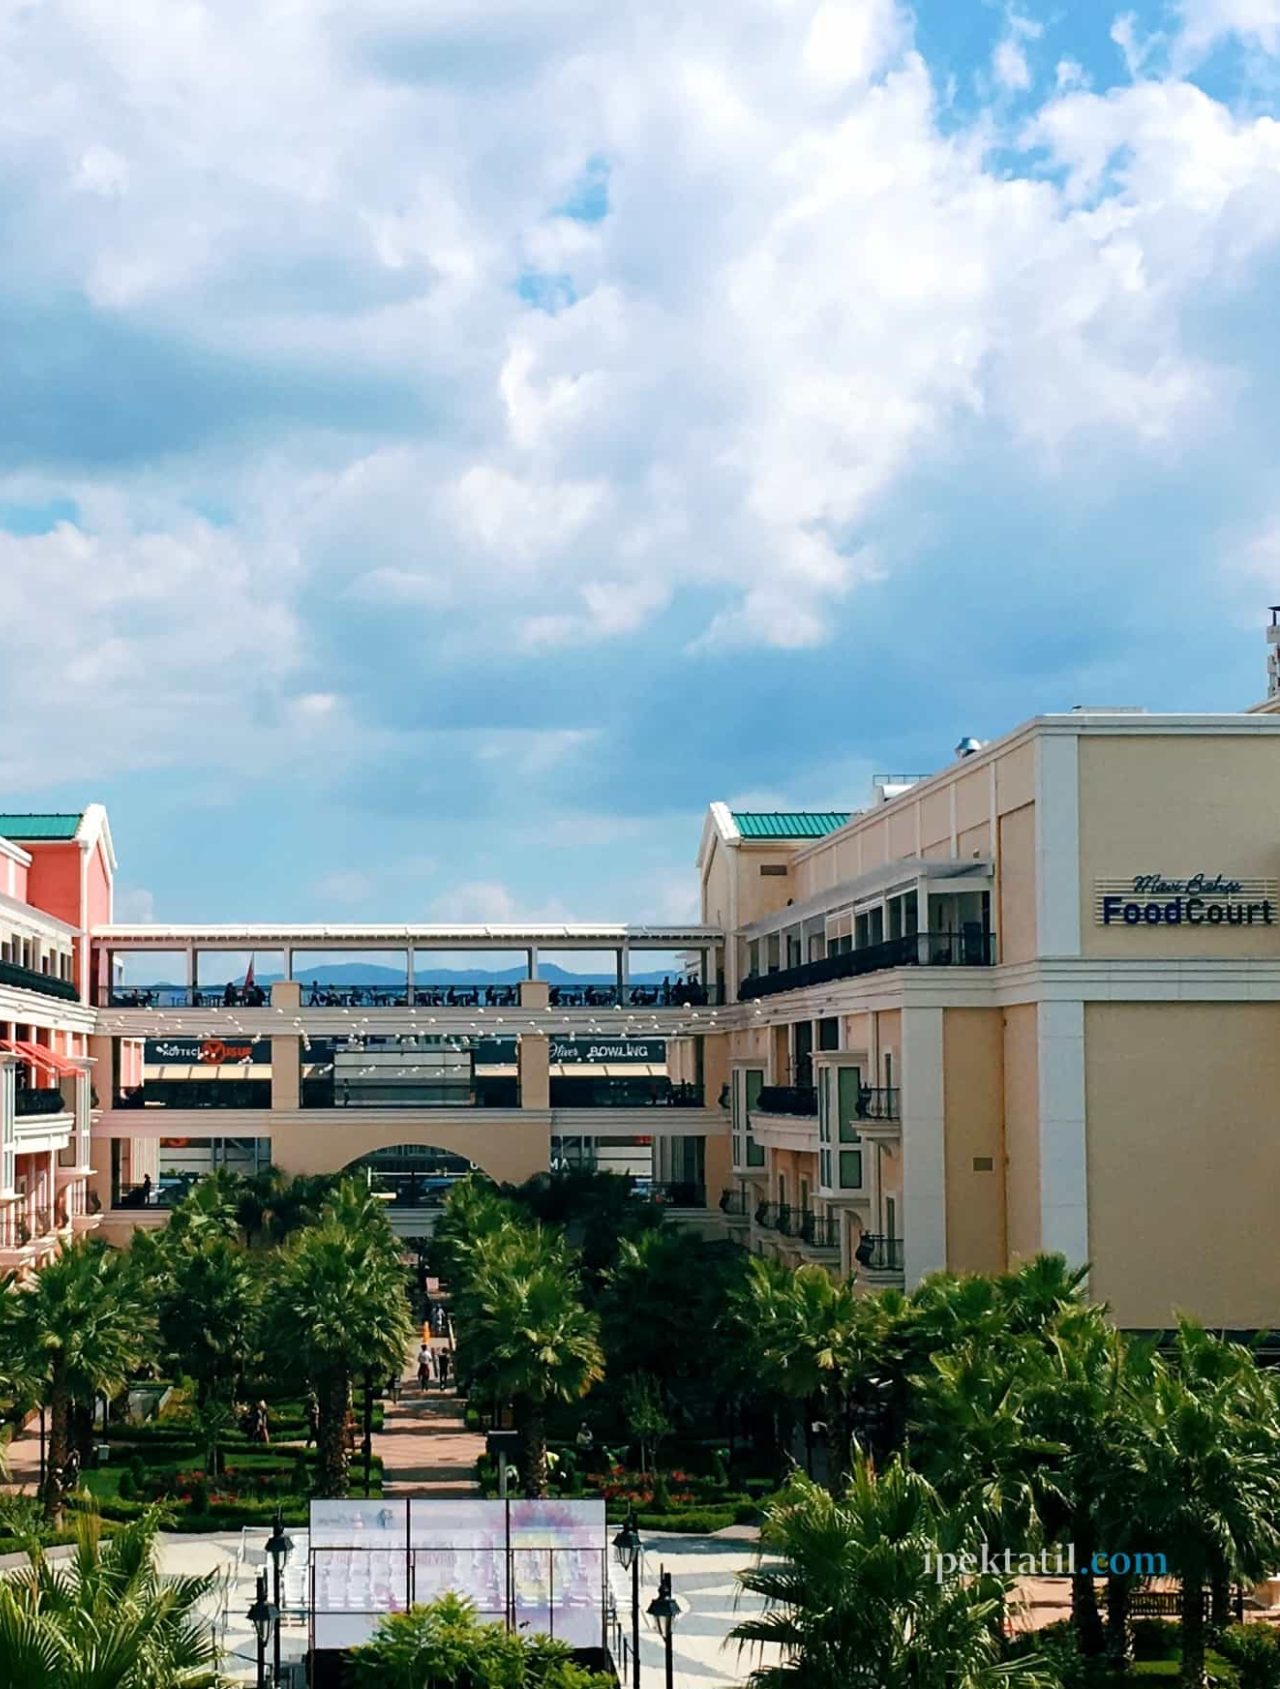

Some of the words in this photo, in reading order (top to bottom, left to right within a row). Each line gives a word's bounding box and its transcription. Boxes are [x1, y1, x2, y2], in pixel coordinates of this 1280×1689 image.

[1133, 874, 1183, 893] Mavi
[1103, 897, 1273, 924] FoodCourt
[589, 1044, 648, 1057] BOWLING
